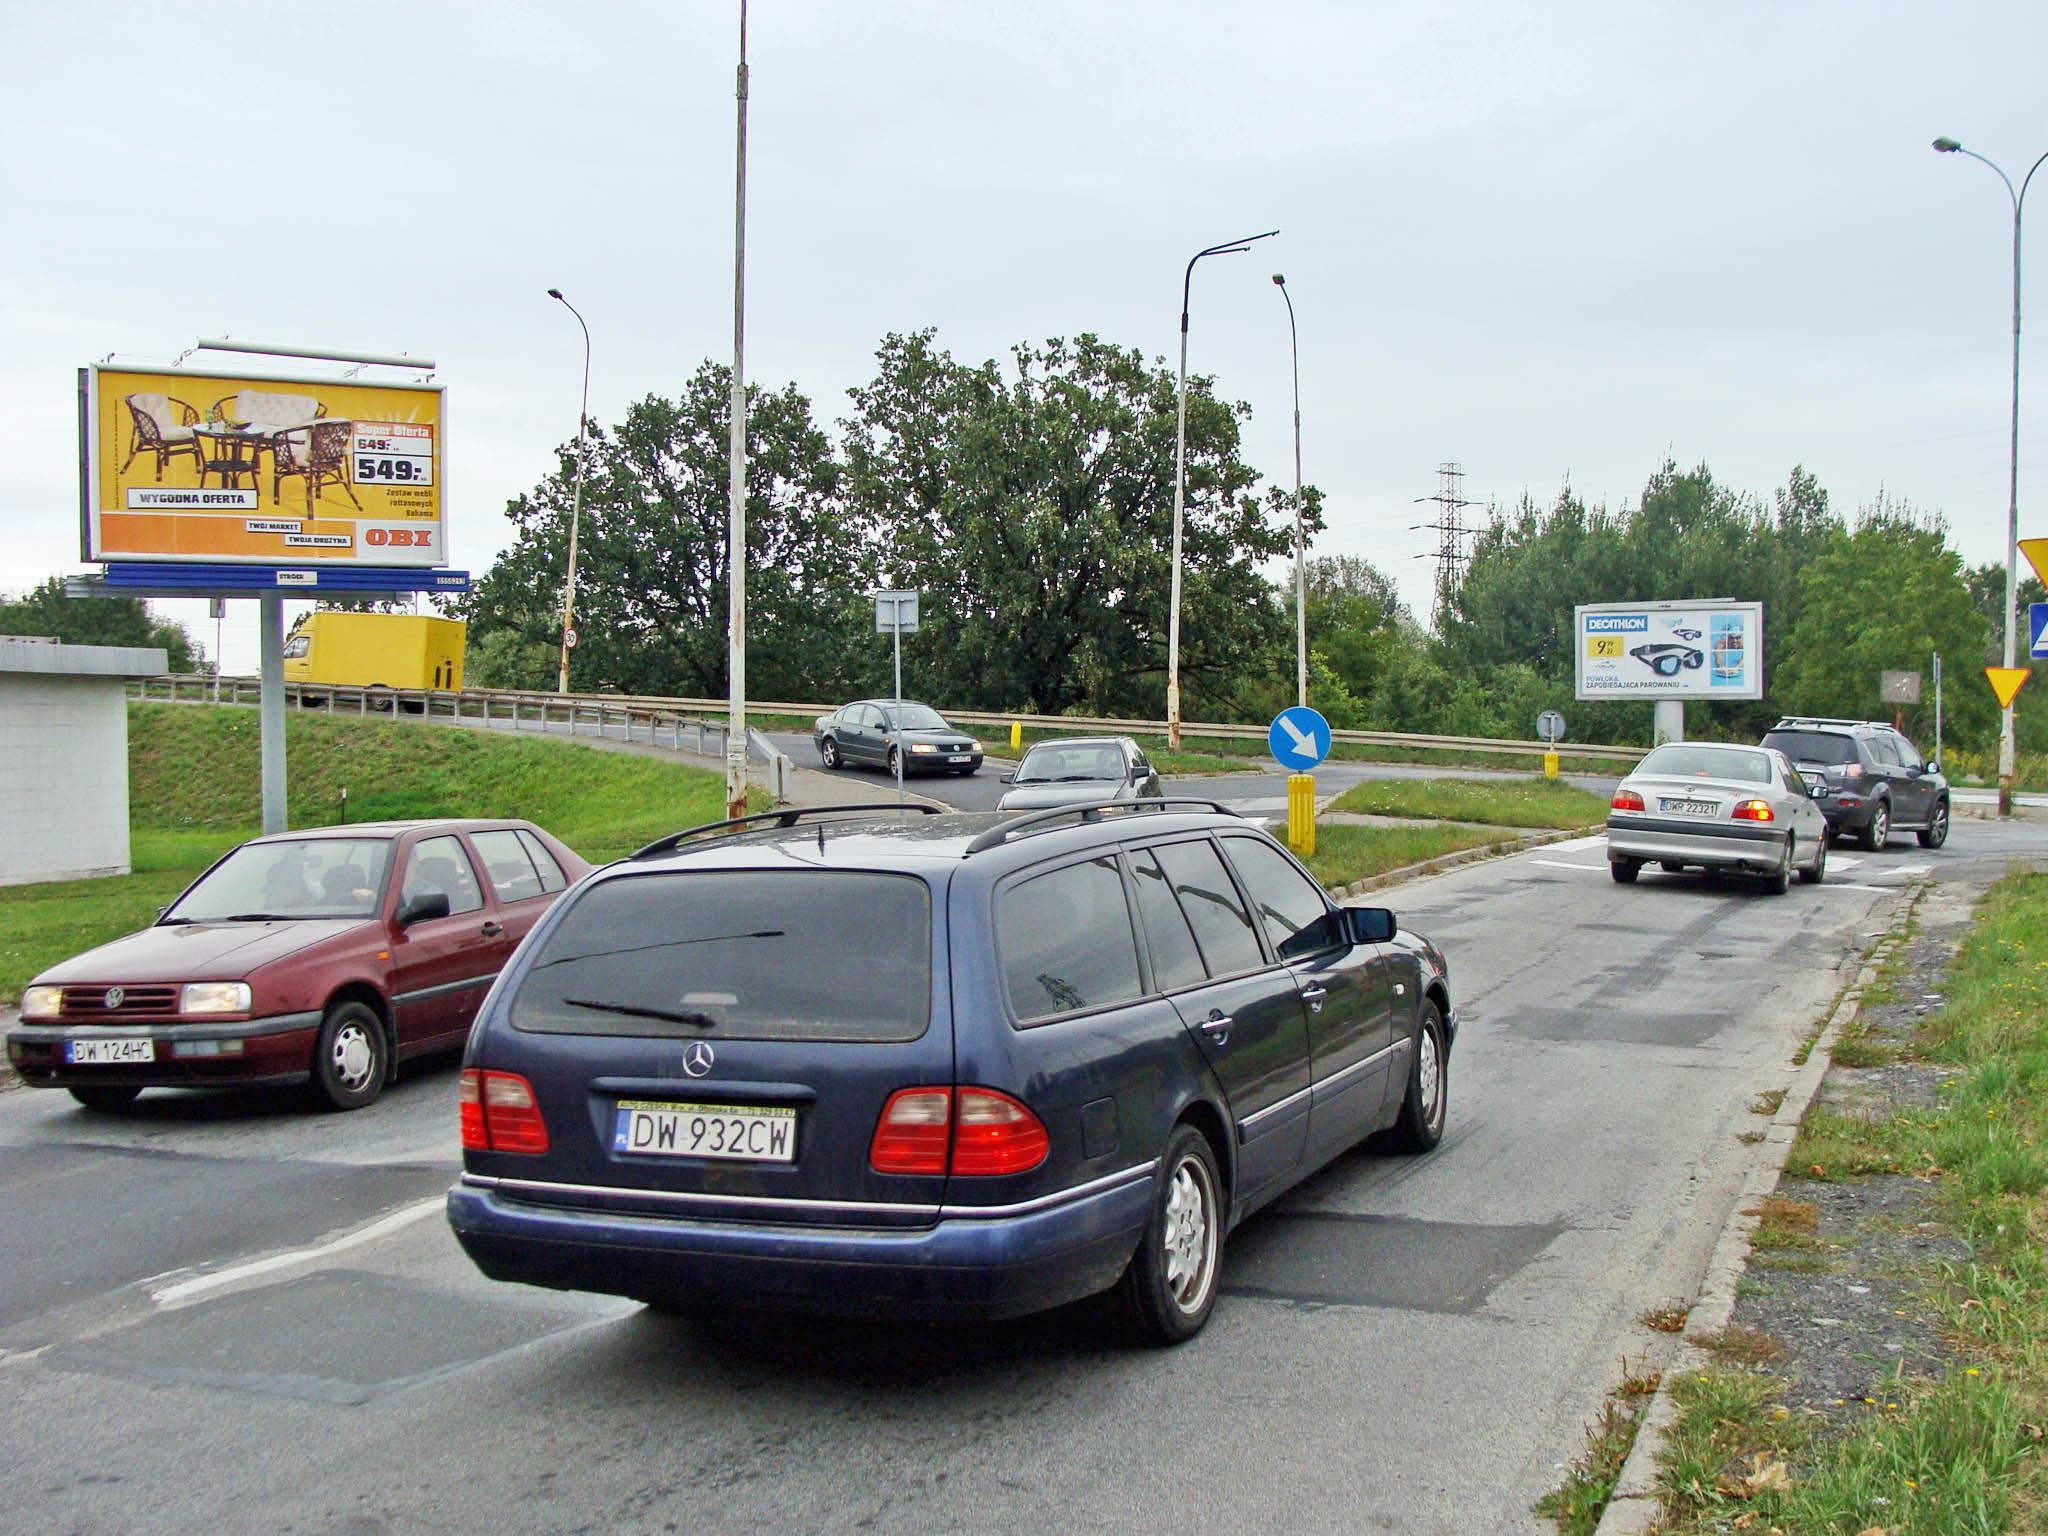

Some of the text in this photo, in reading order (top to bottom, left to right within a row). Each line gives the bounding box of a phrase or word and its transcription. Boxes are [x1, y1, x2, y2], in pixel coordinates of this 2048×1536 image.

[139, 493, 245, 504] WYGODNA OFERTA
[269, 523, 298, 531] MARKET
[366, 529, 432, 546] OBI
[1588, 618, 1645, 629] DECATHLON
[1665, 801, 1685, 812] DWR
[1686, 803, 1714, 815] 22321
[75, 1041, 151, 1061] DW 124HC
[634, 1113, 788, 1155] DW 932CW
